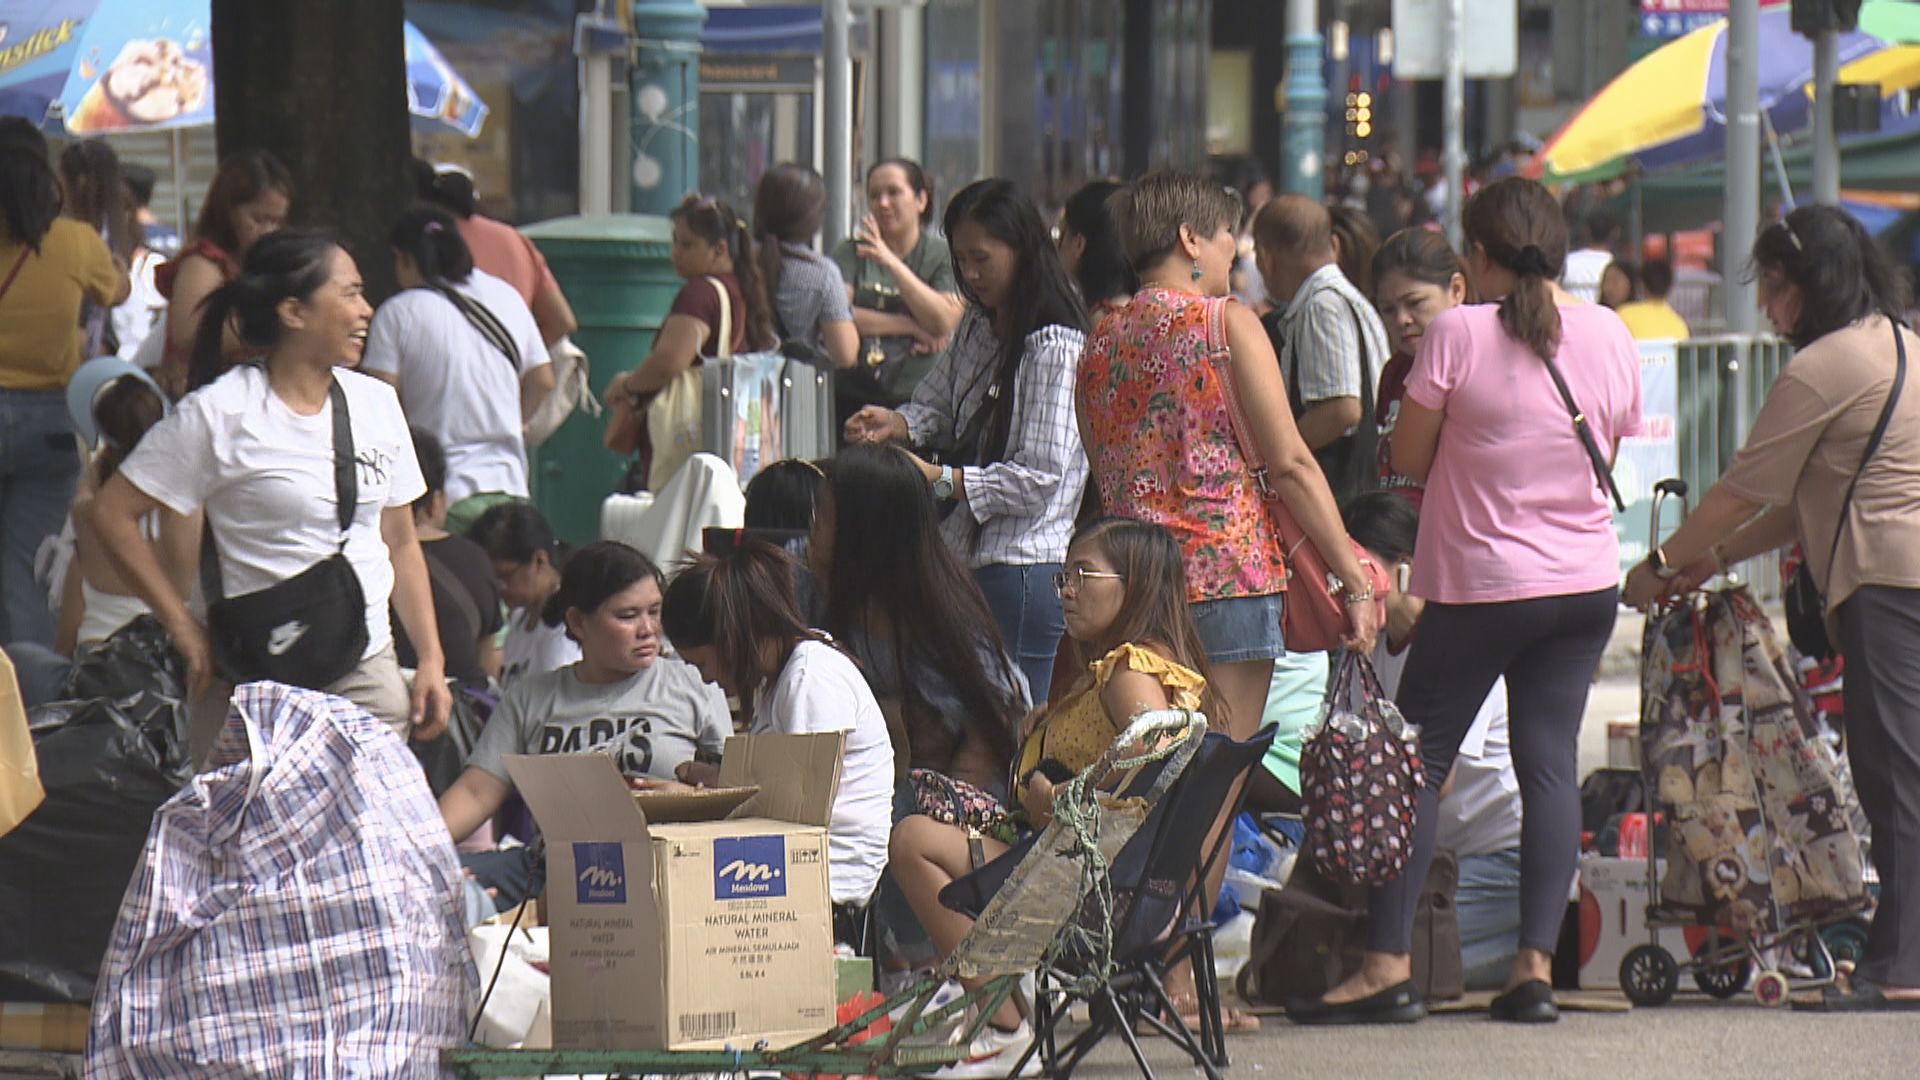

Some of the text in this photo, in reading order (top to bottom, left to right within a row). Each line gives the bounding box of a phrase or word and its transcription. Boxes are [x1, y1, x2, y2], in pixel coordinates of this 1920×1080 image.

[731, 882, 769, 894] Meadows
[705, 911, 798, 926] NATURAL MINERAL
[735, 928, 769, 940] WATER
